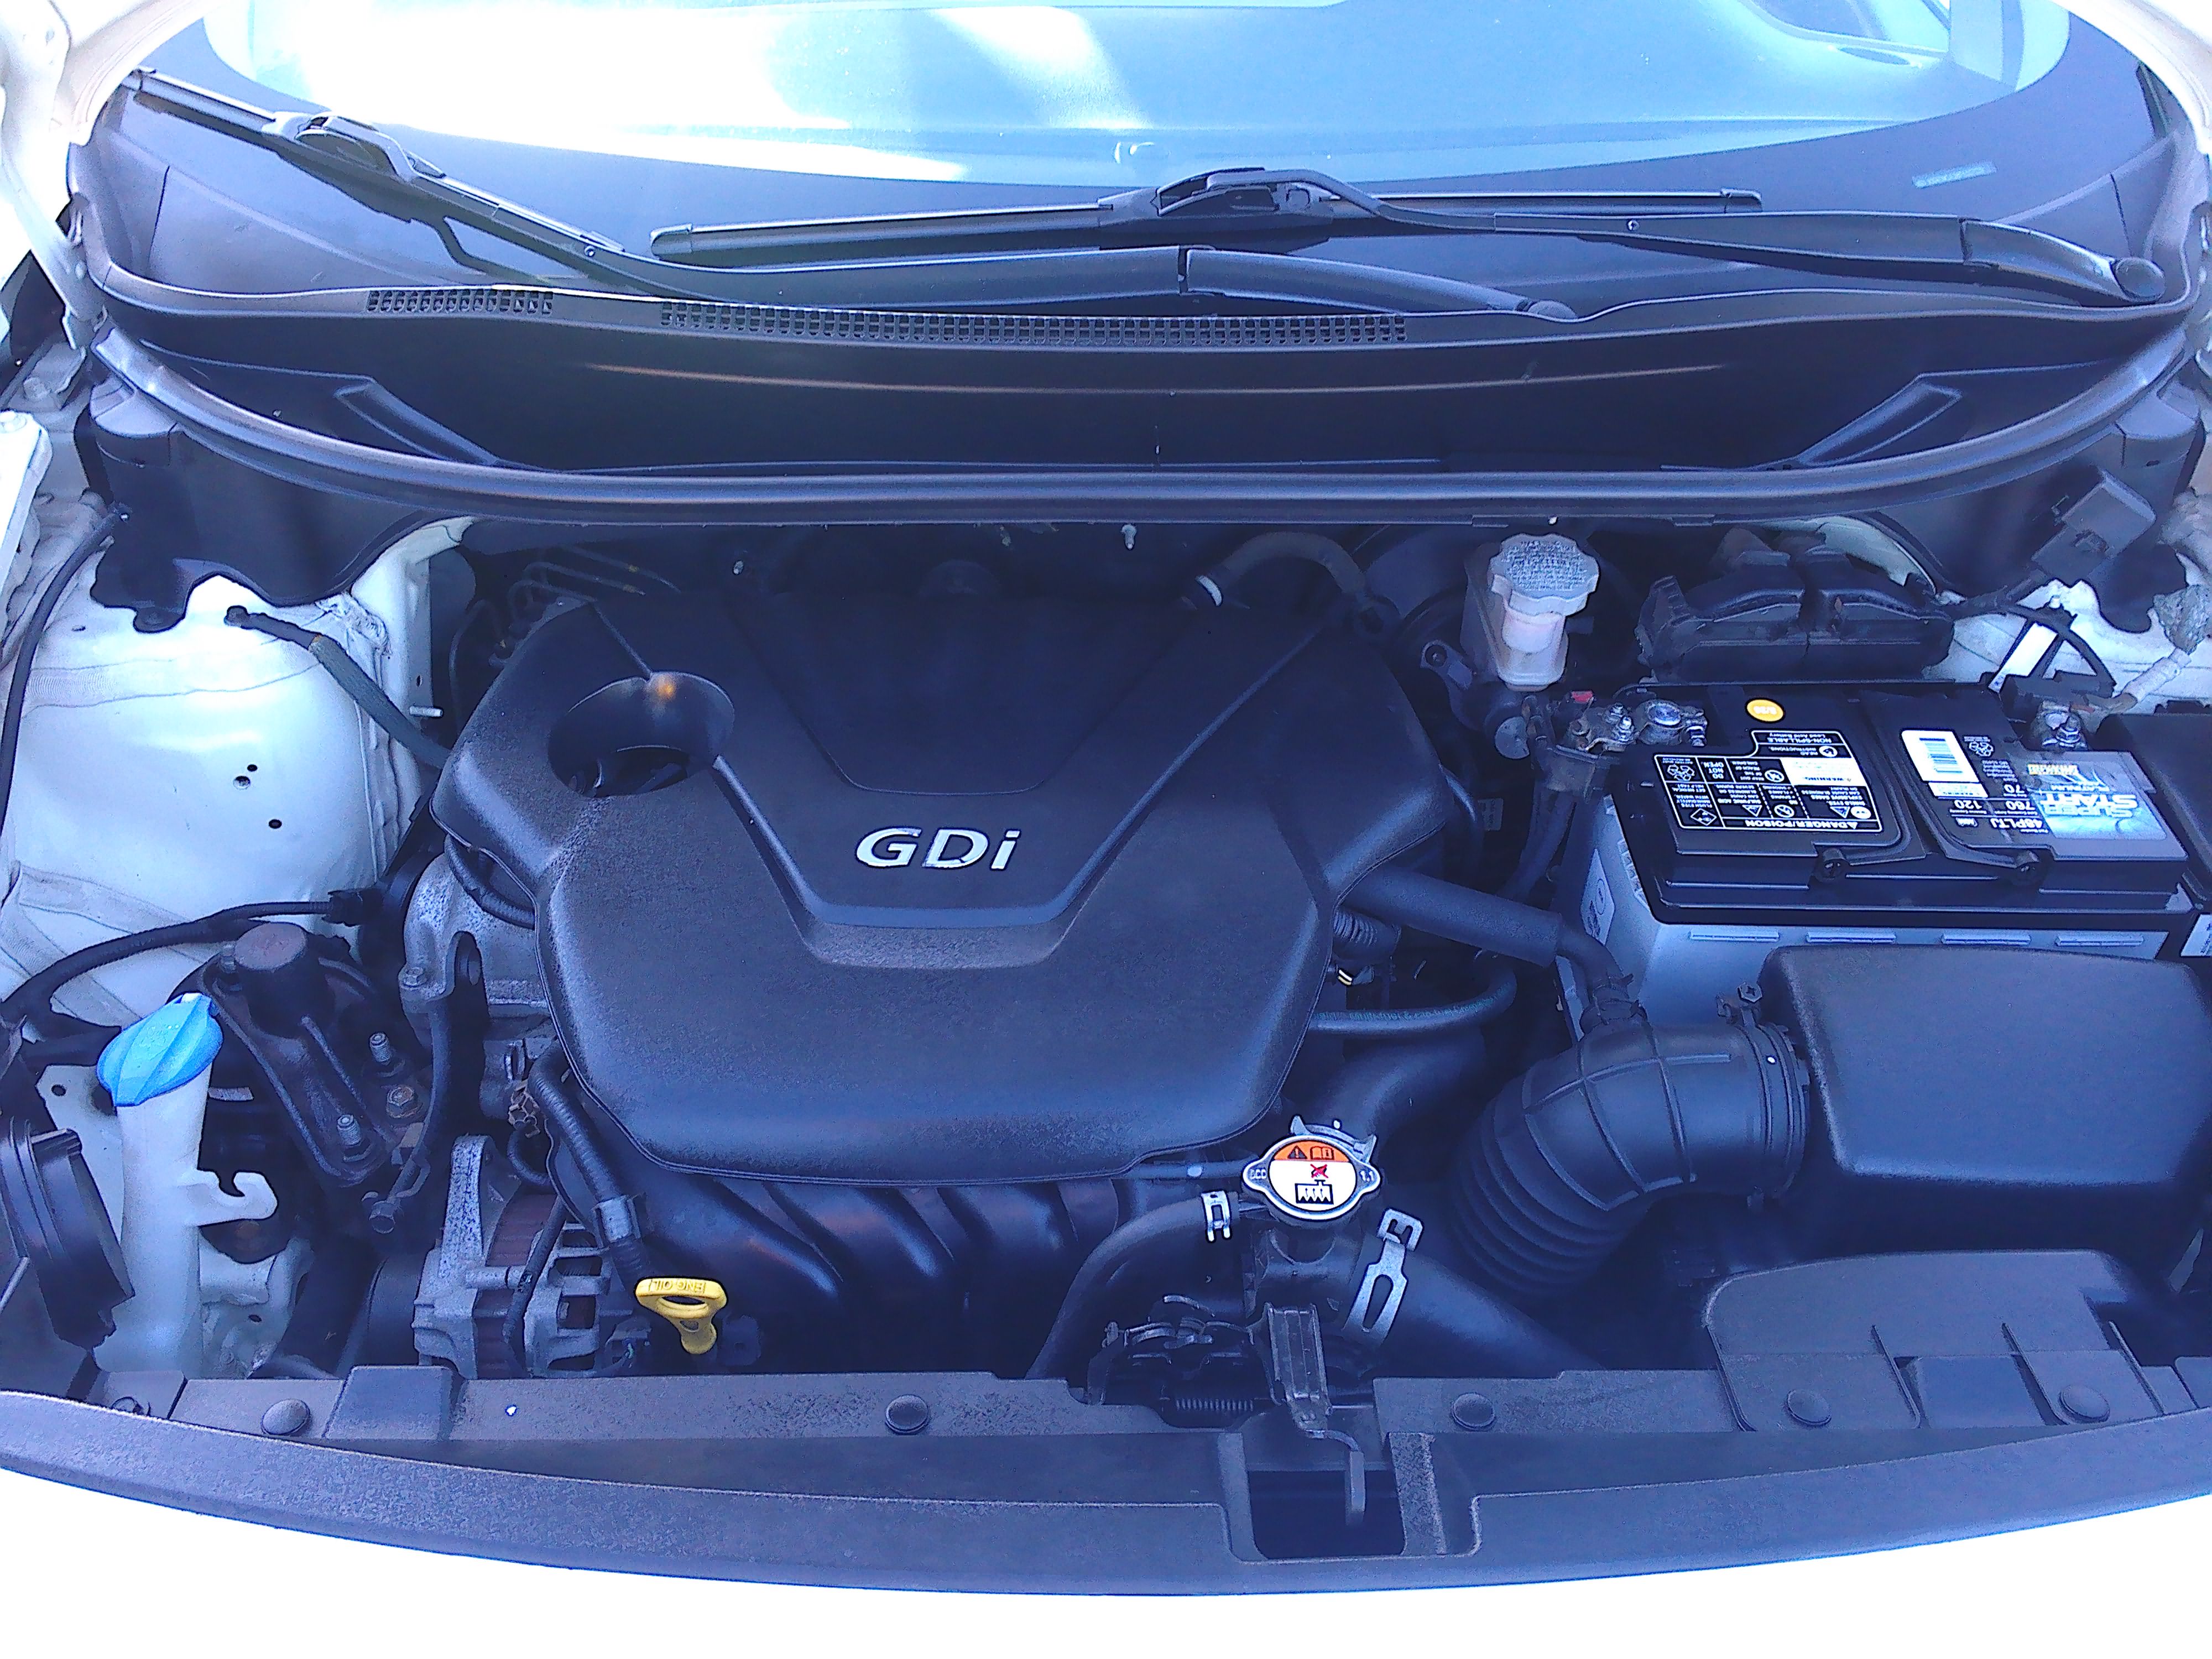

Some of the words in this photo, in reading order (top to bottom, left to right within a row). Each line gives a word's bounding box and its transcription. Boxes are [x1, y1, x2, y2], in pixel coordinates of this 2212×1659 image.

[2004, 784, 2025, 794] 70
[1954, 799, 1983, 809] 120
[2039, 793, 2138, 808] START
[2044, 805, 2133, 818] SUPER
[1744, 820, 1848, 828] DANGER/POISON
[856, 828, 1021, 869] GDi
[1360, 1170, 1374, 1182] 1.1
[653, 1280, 672, 1292] OIL
[677, 1282, 704, 1293] ENG
